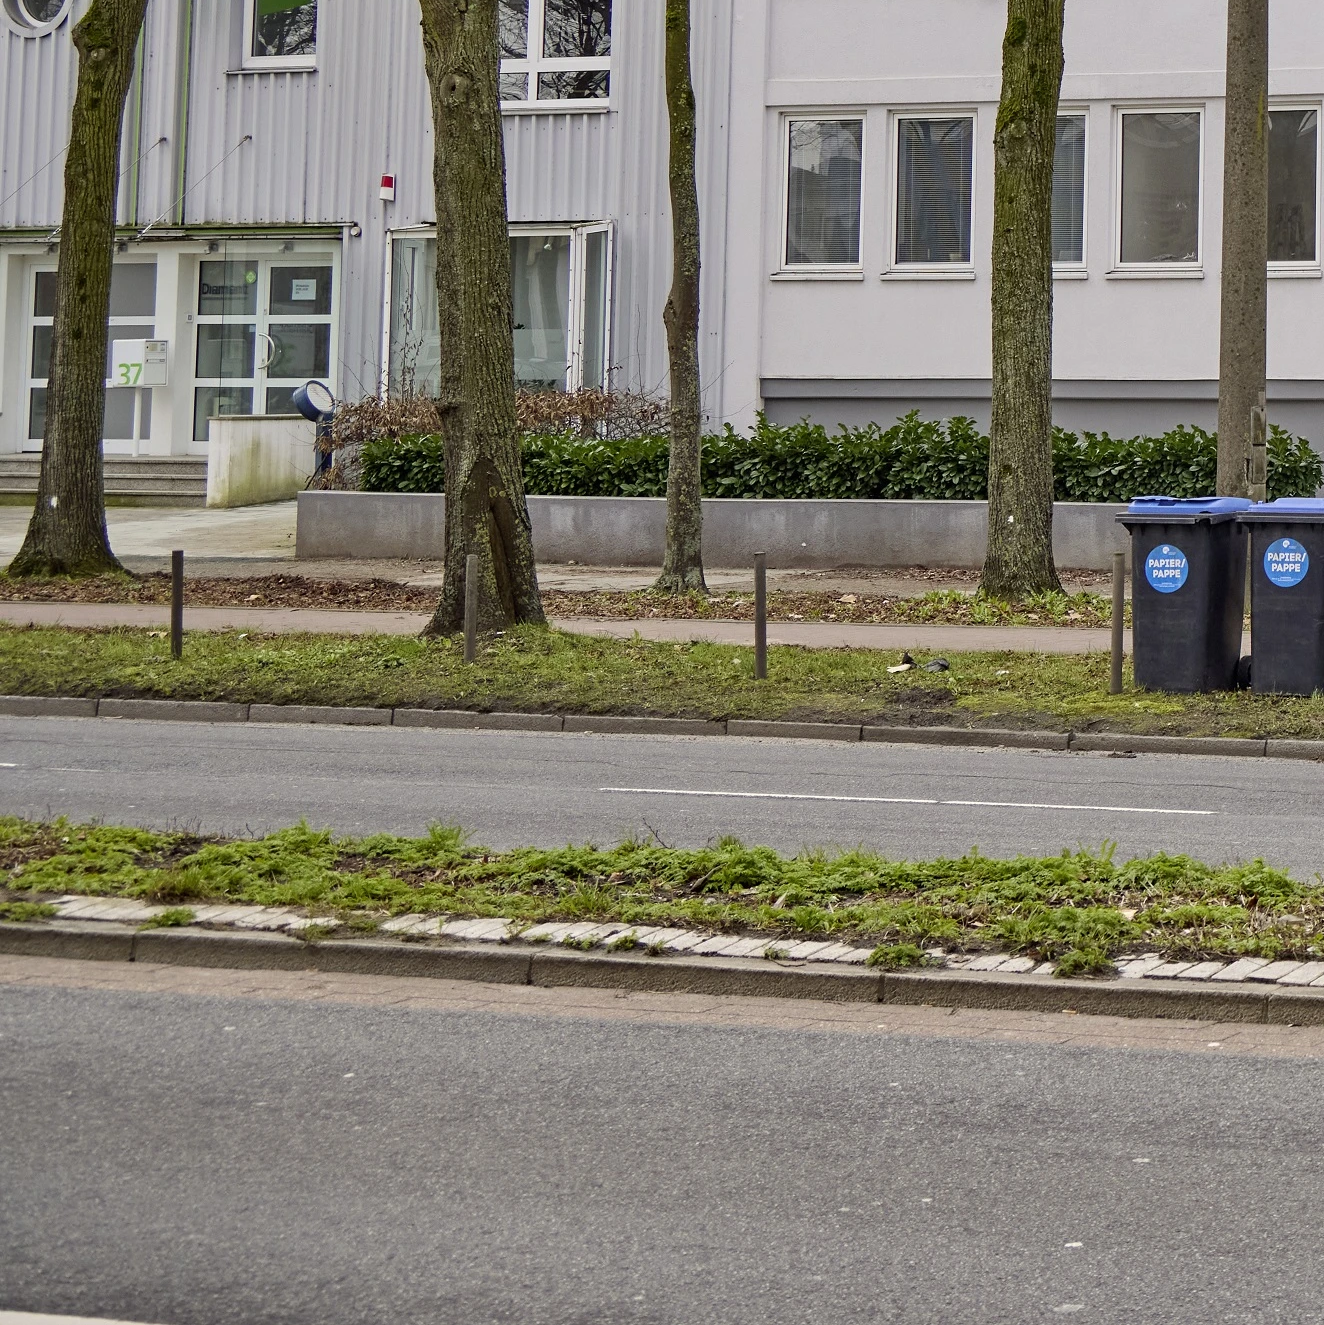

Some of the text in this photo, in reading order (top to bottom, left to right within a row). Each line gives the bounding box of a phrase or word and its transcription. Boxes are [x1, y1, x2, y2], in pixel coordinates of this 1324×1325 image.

[118, 362, 143, 385] 37
[1267, 552, 1307, 563] PAPIER/
[1148, 558, 1186, 569] PAPIER/
[1271, 563, 1301, 572] PAPPE
[1152, 569, 1182, 578] PAPPE
